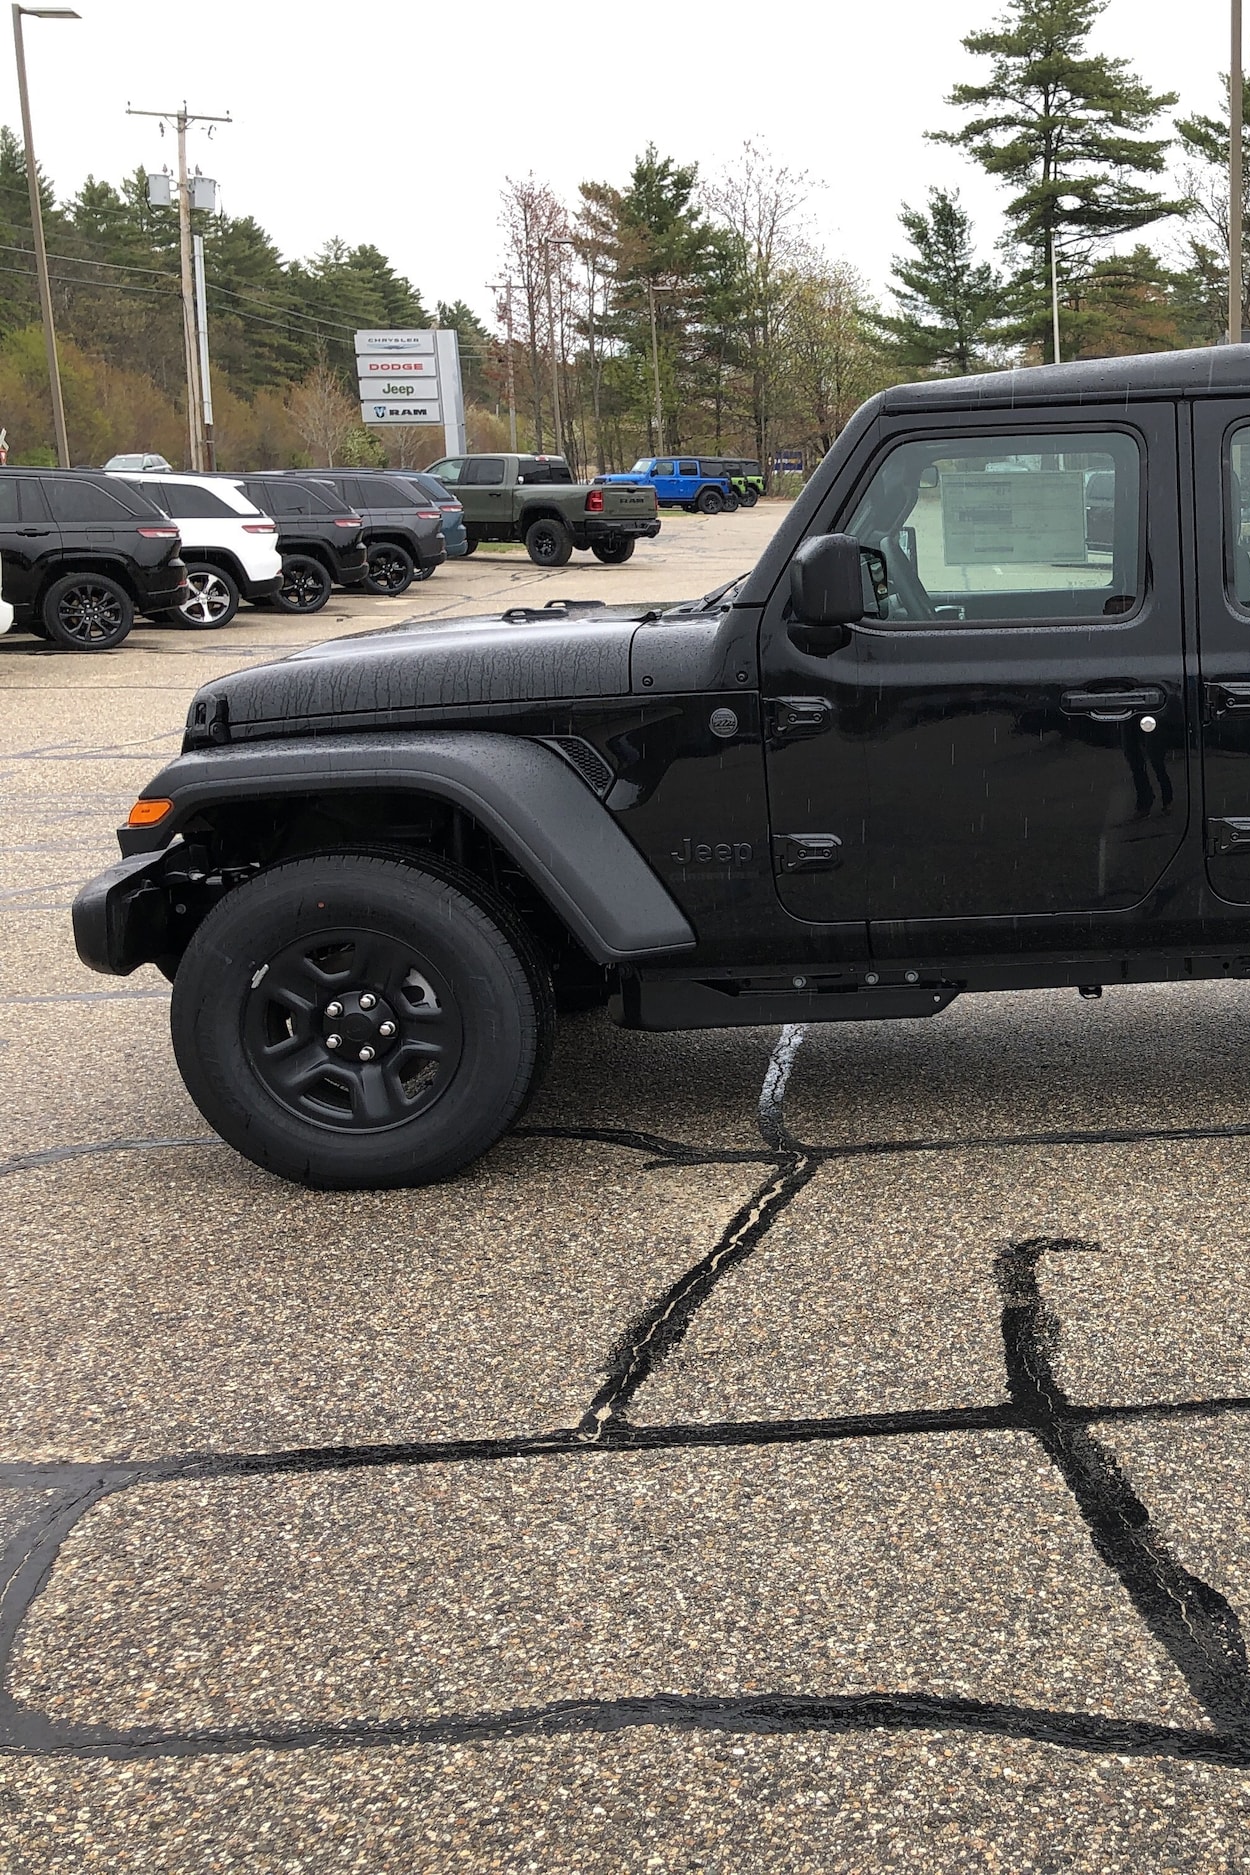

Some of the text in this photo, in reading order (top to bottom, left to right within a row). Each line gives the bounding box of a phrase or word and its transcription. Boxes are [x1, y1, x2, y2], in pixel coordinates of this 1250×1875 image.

[369, 363, 424, 371] DODGE
[382, 383, 415, 396] Jeep
[389, 408, 427, 416] RAM
[670, 838, 753, 867] Jeep
